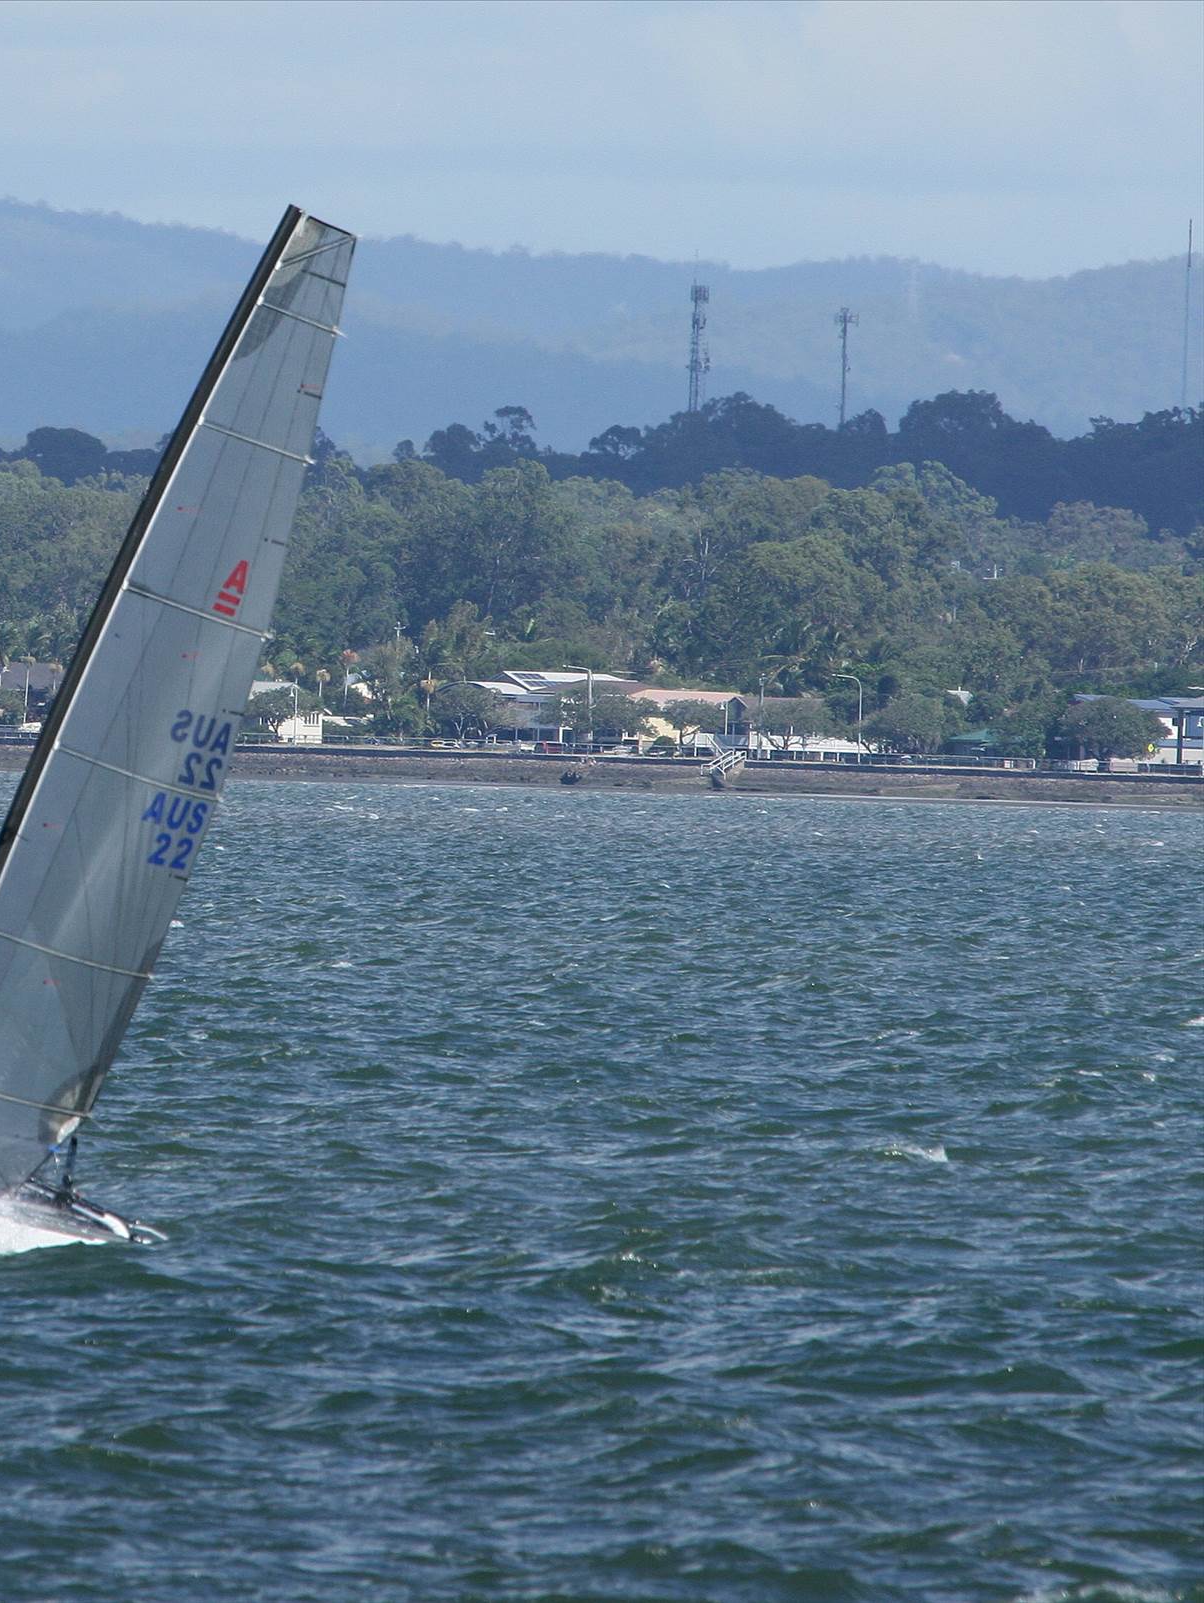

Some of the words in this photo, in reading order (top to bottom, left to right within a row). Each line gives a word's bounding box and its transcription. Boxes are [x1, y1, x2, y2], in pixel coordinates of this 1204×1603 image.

[223, 559, 249, 594] A
[141, 792, 208, 835] AUS
[147, 832, 193, 870] 22
